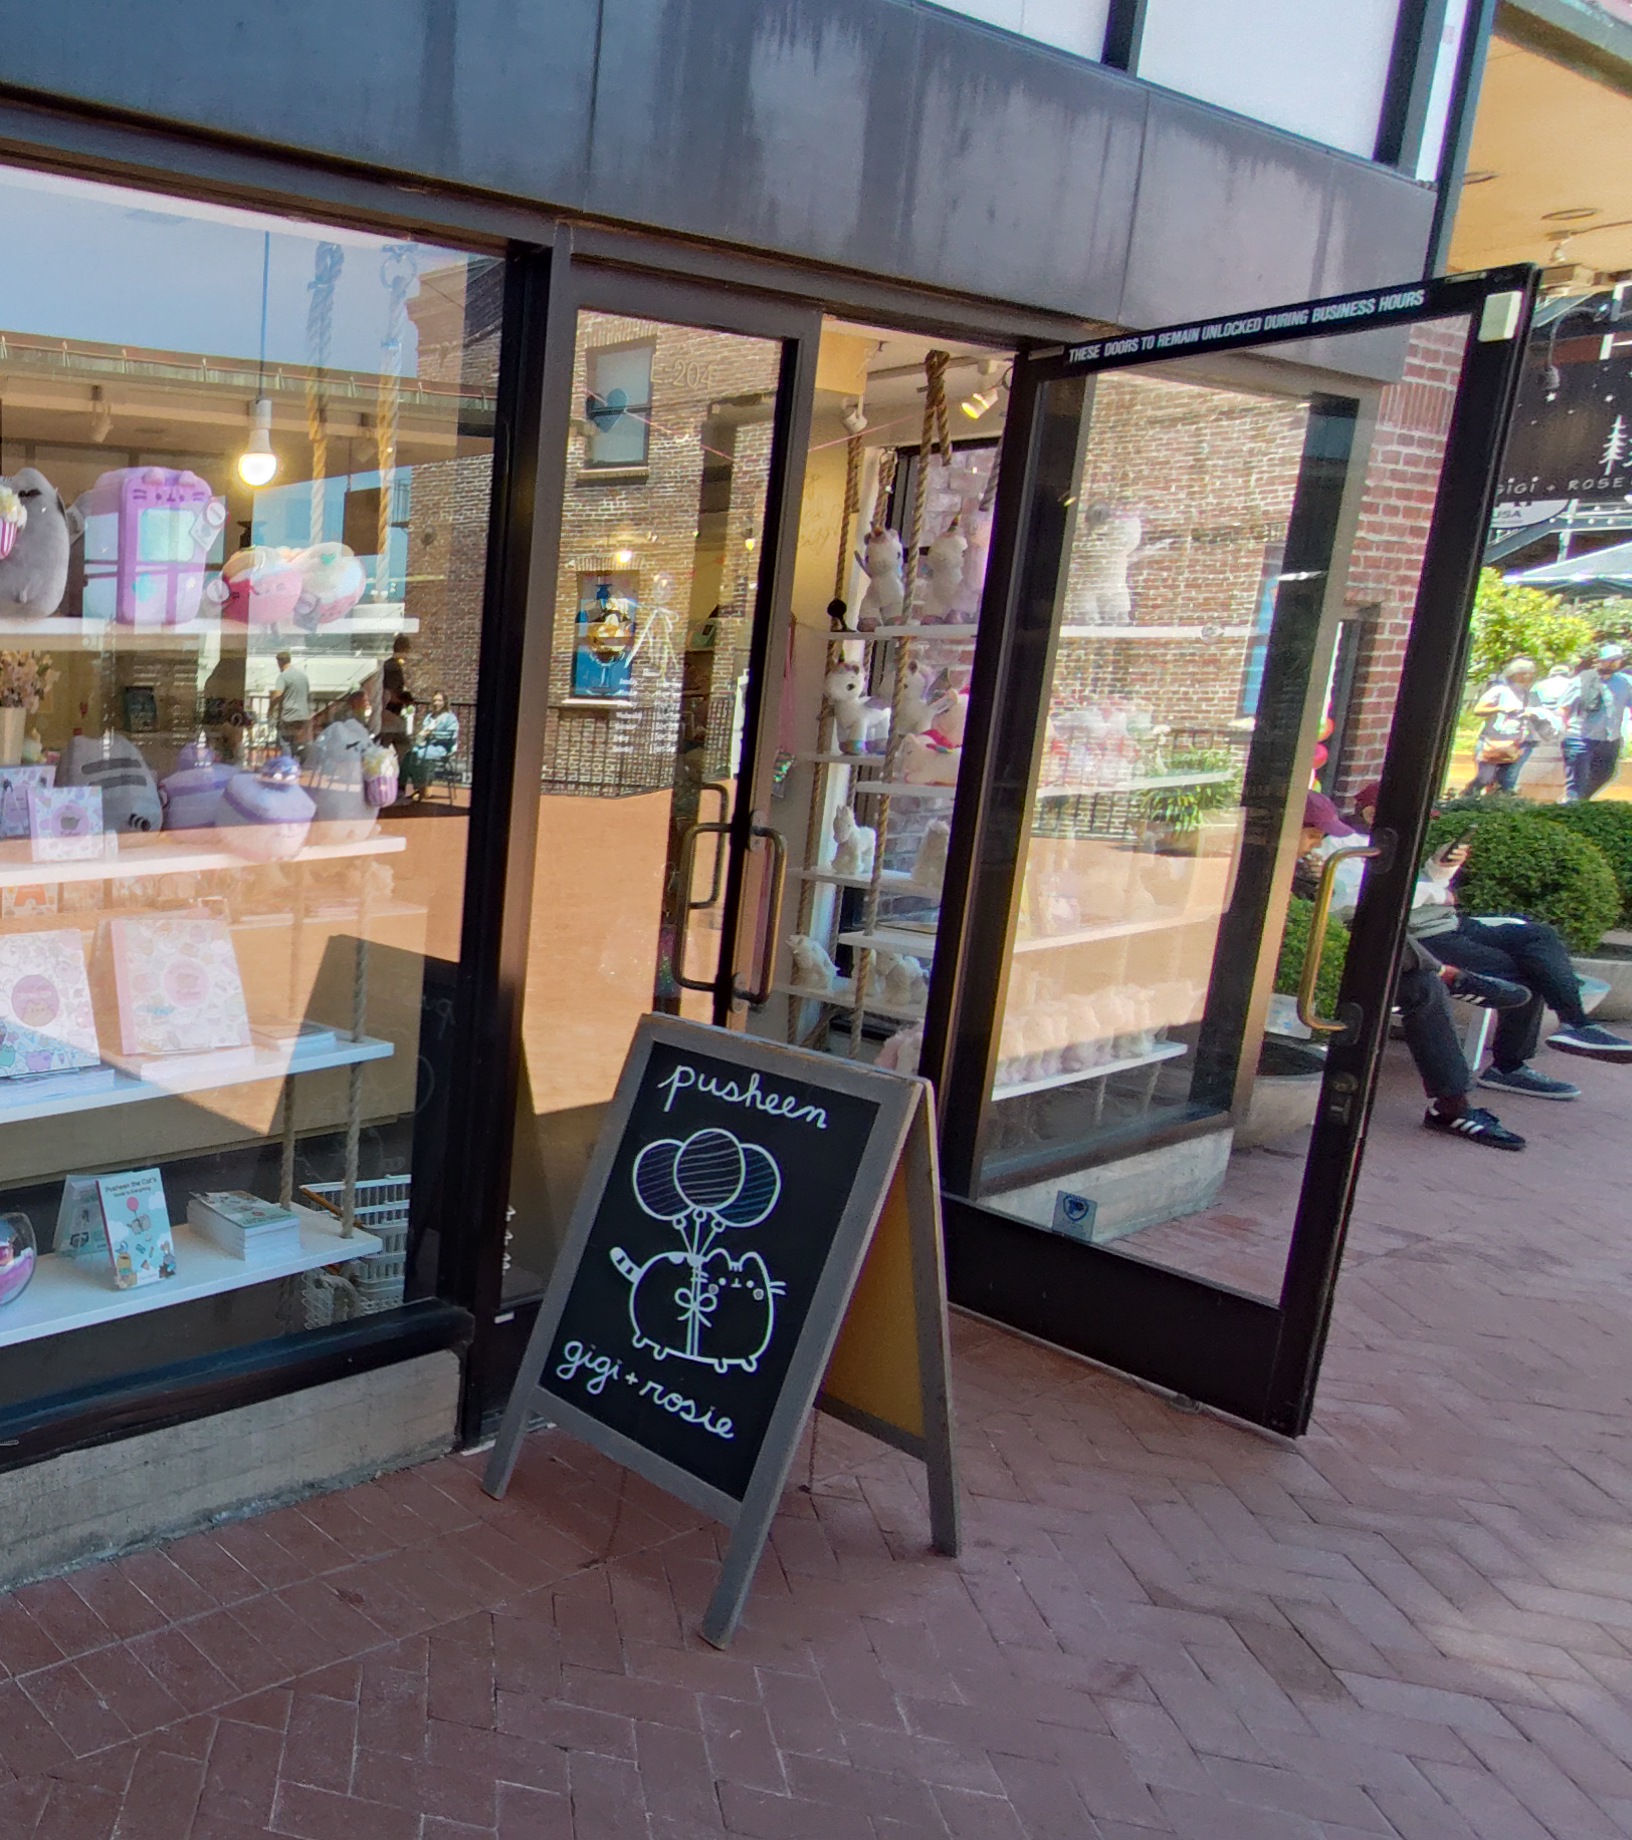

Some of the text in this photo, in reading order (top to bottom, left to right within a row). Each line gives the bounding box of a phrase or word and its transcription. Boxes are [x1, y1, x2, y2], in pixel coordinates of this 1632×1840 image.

[1069, 289, 1425, 363] THESE DOORS TO REMAIN UNLOCKED DURING BUSINESS HOURS
[657, 1064, 828, 1129] pusheen
[555, 1339, 624, 1396] gigi
[638, 1378, 736, 1440] rosie
